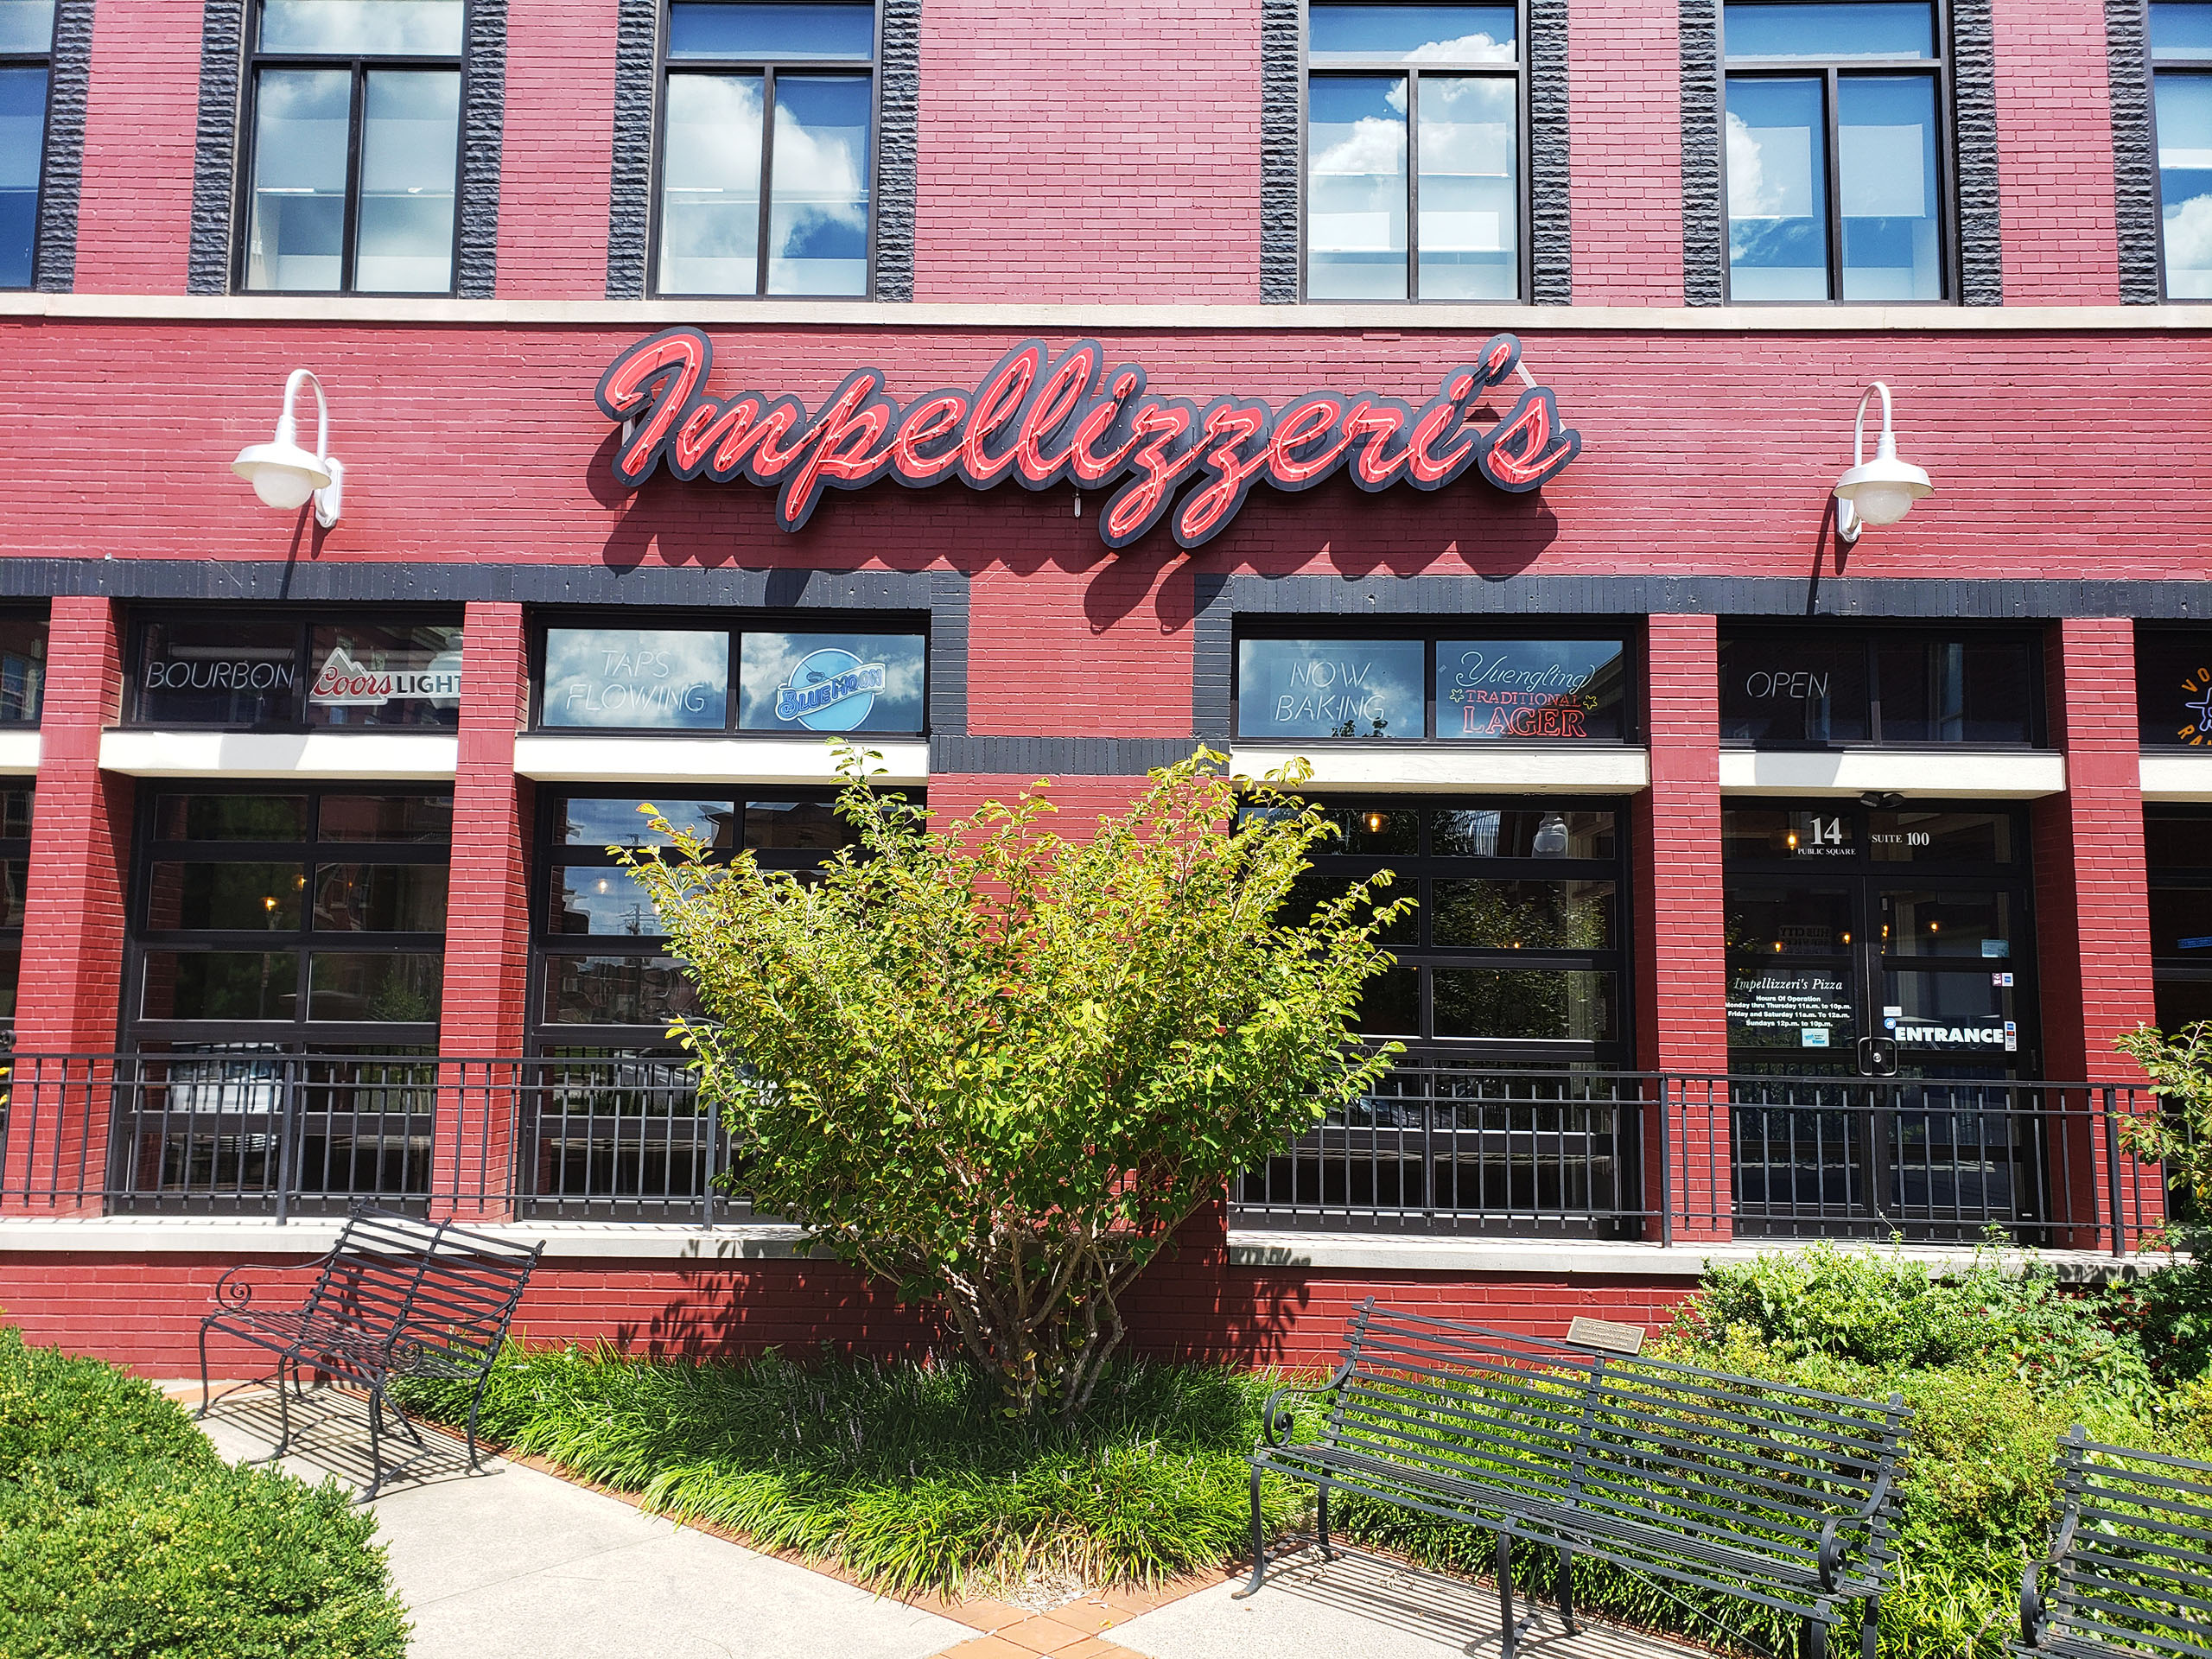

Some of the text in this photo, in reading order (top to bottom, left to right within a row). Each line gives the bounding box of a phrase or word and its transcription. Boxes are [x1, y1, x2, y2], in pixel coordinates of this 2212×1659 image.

[603, 330, 1576, 544] Impellizzeri's
[146, 662, 296, 690] BOURBON
[601, 650, 670, 678] TAPS
[1289, 661, 1372, 689] NOW
[1455, 651, 1596, 696] Yuengling
[314, 666, 393, 696] Coors
[1746, 671, 1828, 699] OPEN
[565, 683, 706, 713] FLOWING
[1274, 695, 1385, 722] BAKING
[1465, 690, 1582, 708] TRADITIONAL
[1463, 706, 1587, 738] LAGER
[1809, 817, 1842, 845] 14
[1872, 832, 1930, 846] SUITE 100
[1733, 977, 1843, 993] Impellizzeri's Pizza
[1895, 1027, 2004, 1043] ENTRANCE
